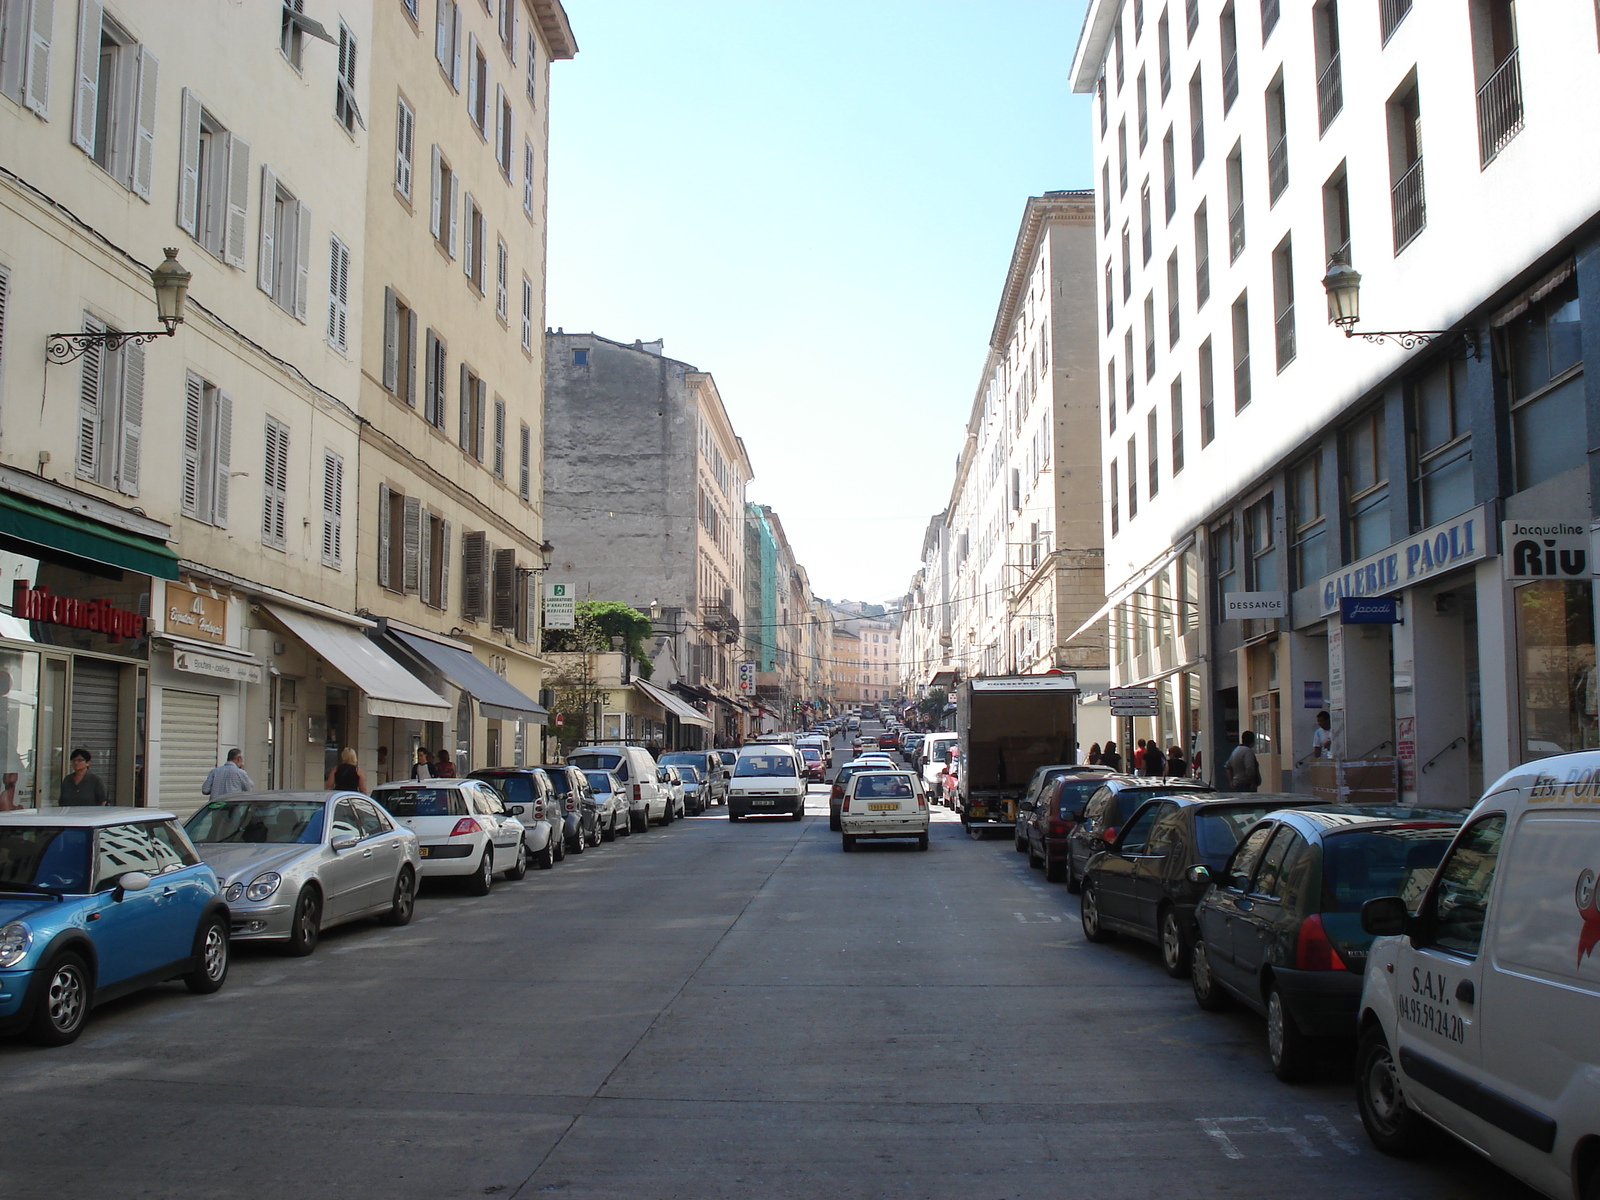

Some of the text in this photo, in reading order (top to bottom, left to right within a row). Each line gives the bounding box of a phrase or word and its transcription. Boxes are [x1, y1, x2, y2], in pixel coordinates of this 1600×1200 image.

[1512, 524, 1583, 536] Jacqueline
[1324, 519, 1475, 610] GALERIE PAOLI
[1513, 540, 1586, 575] Riu
[12, 579, 143, 643] Informatique
[1230, 601, 1282, 610] DESSANGE
[1350, 602, 1391, 618] jacadi
[1412, 967, 1449, 1005] S.A.V.
[1399, 994, 1464, 1045] 04.95.59.24.20
